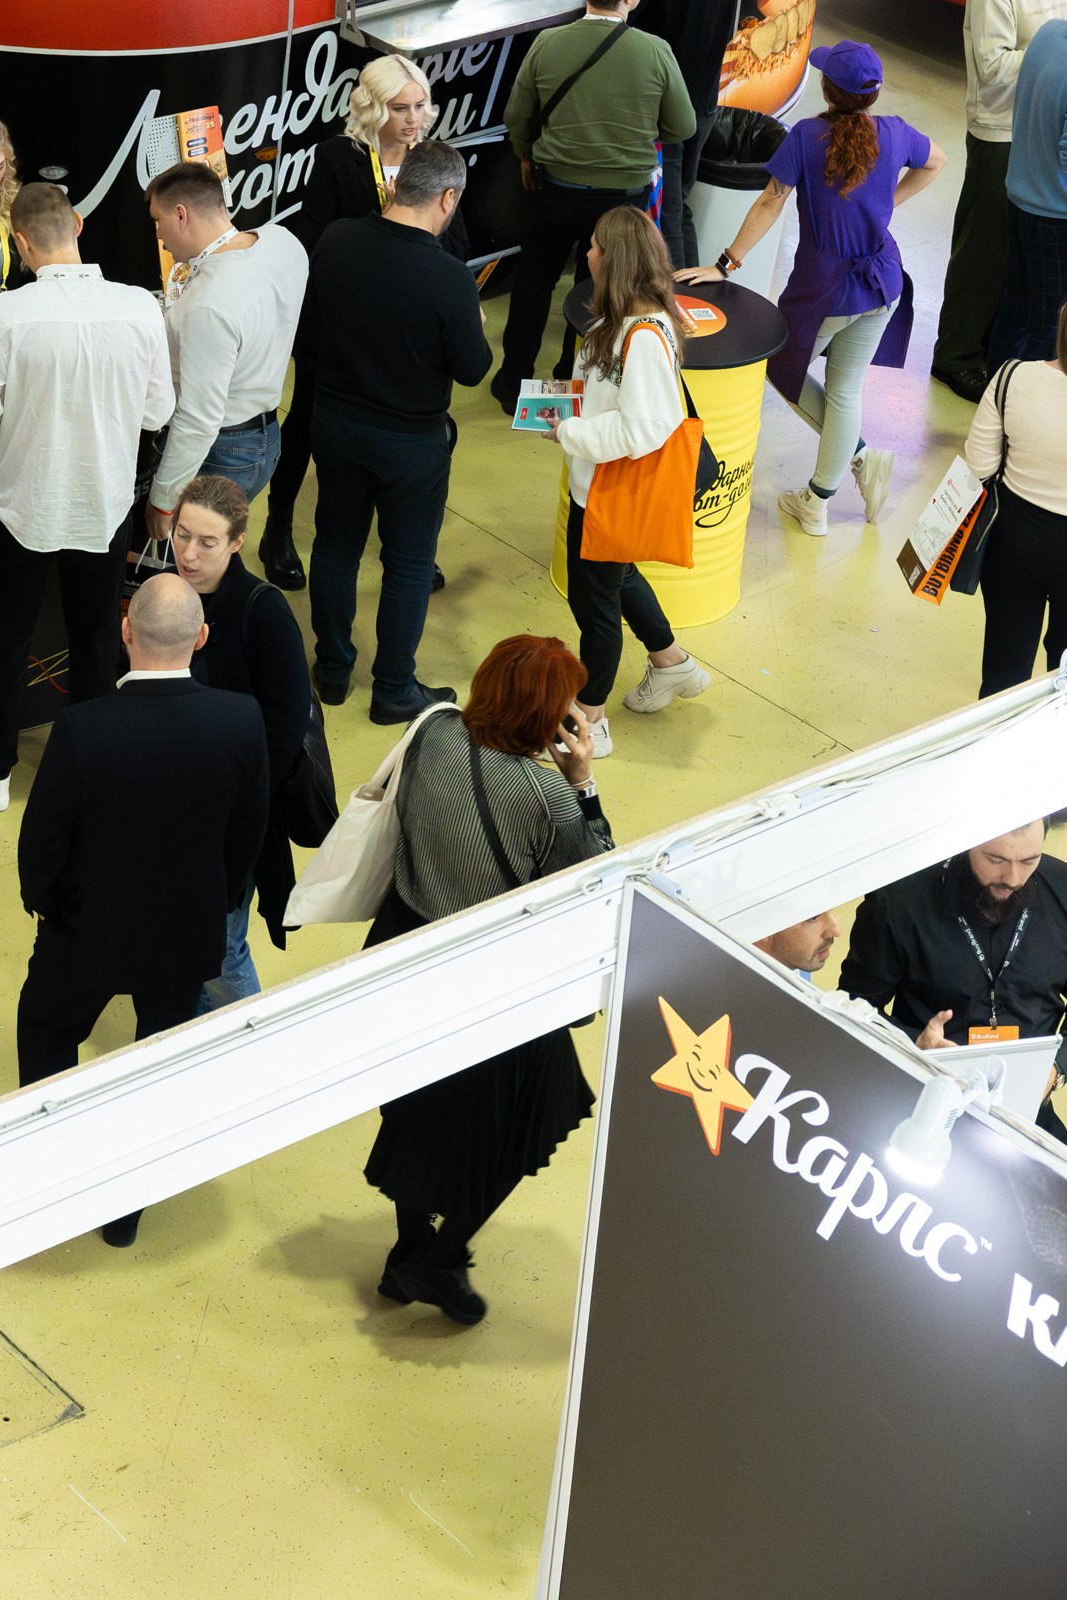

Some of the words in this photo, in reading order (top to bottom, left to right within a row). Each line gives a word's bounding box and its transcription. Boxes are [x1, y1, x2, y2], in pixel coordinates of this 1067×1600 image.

[921, 529, 964, 598] BUYBRAND
[1018, 908, 1029, 931] yBrand
[732, 1053, 981, 1284] Карлс
